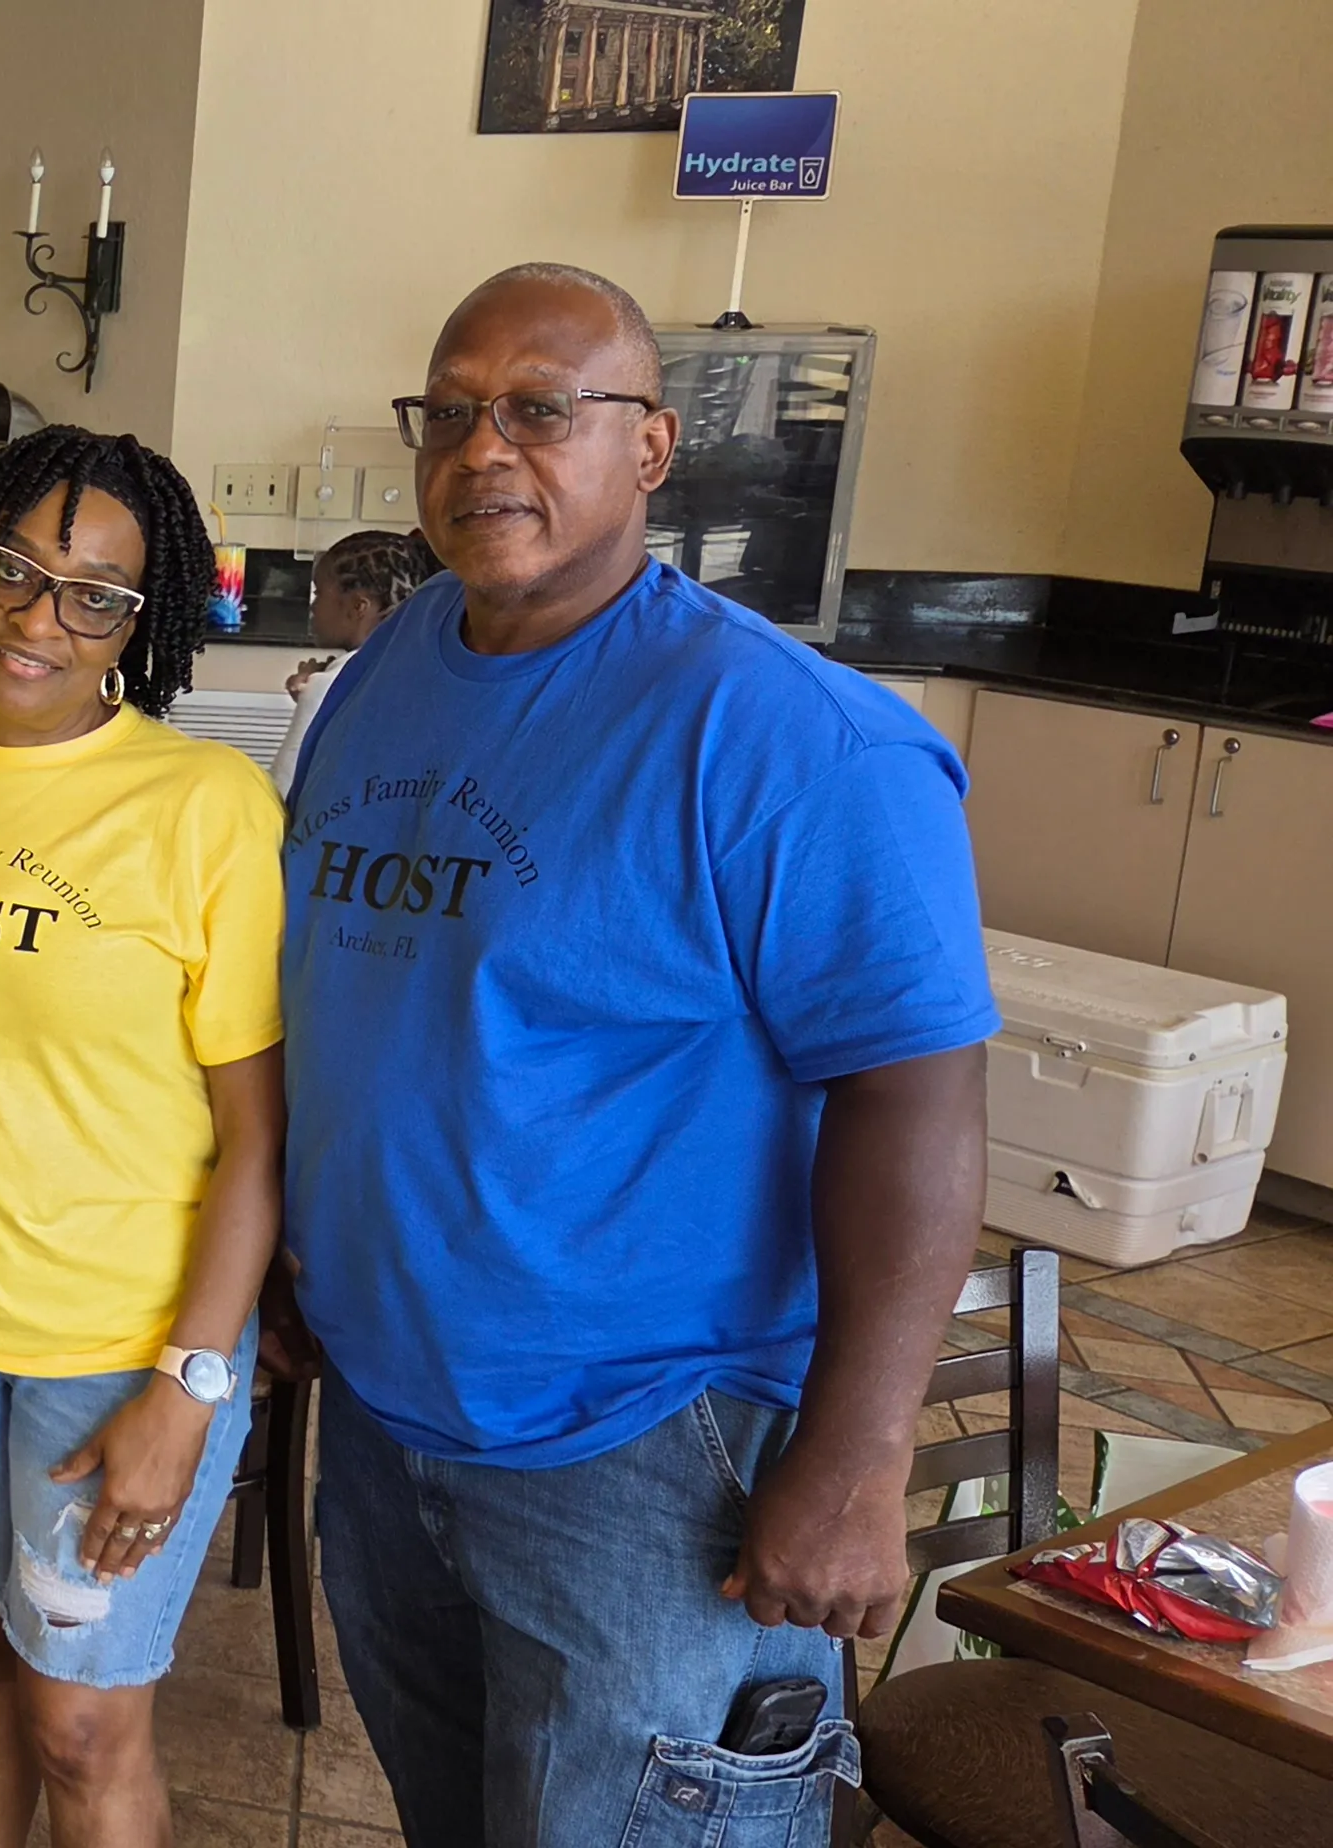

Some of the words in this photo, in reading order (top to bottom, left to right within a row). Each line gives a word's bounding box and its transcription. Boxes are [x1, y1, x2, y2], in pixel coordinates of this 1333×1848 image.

[685, 152, 797, 178] Hydrate
[730, 179, 766, 191] Juice
[769, 179, 794, 191] Bar
[286, 796, 352, 854] Moss
[360, 769, 446, 807] Family
[448, 776, 539, 889] Reunion
[7, 846, 103, 929] Reunion
[309, 840, 491, 918] HOST
[393, 936, 418, 960] FL
